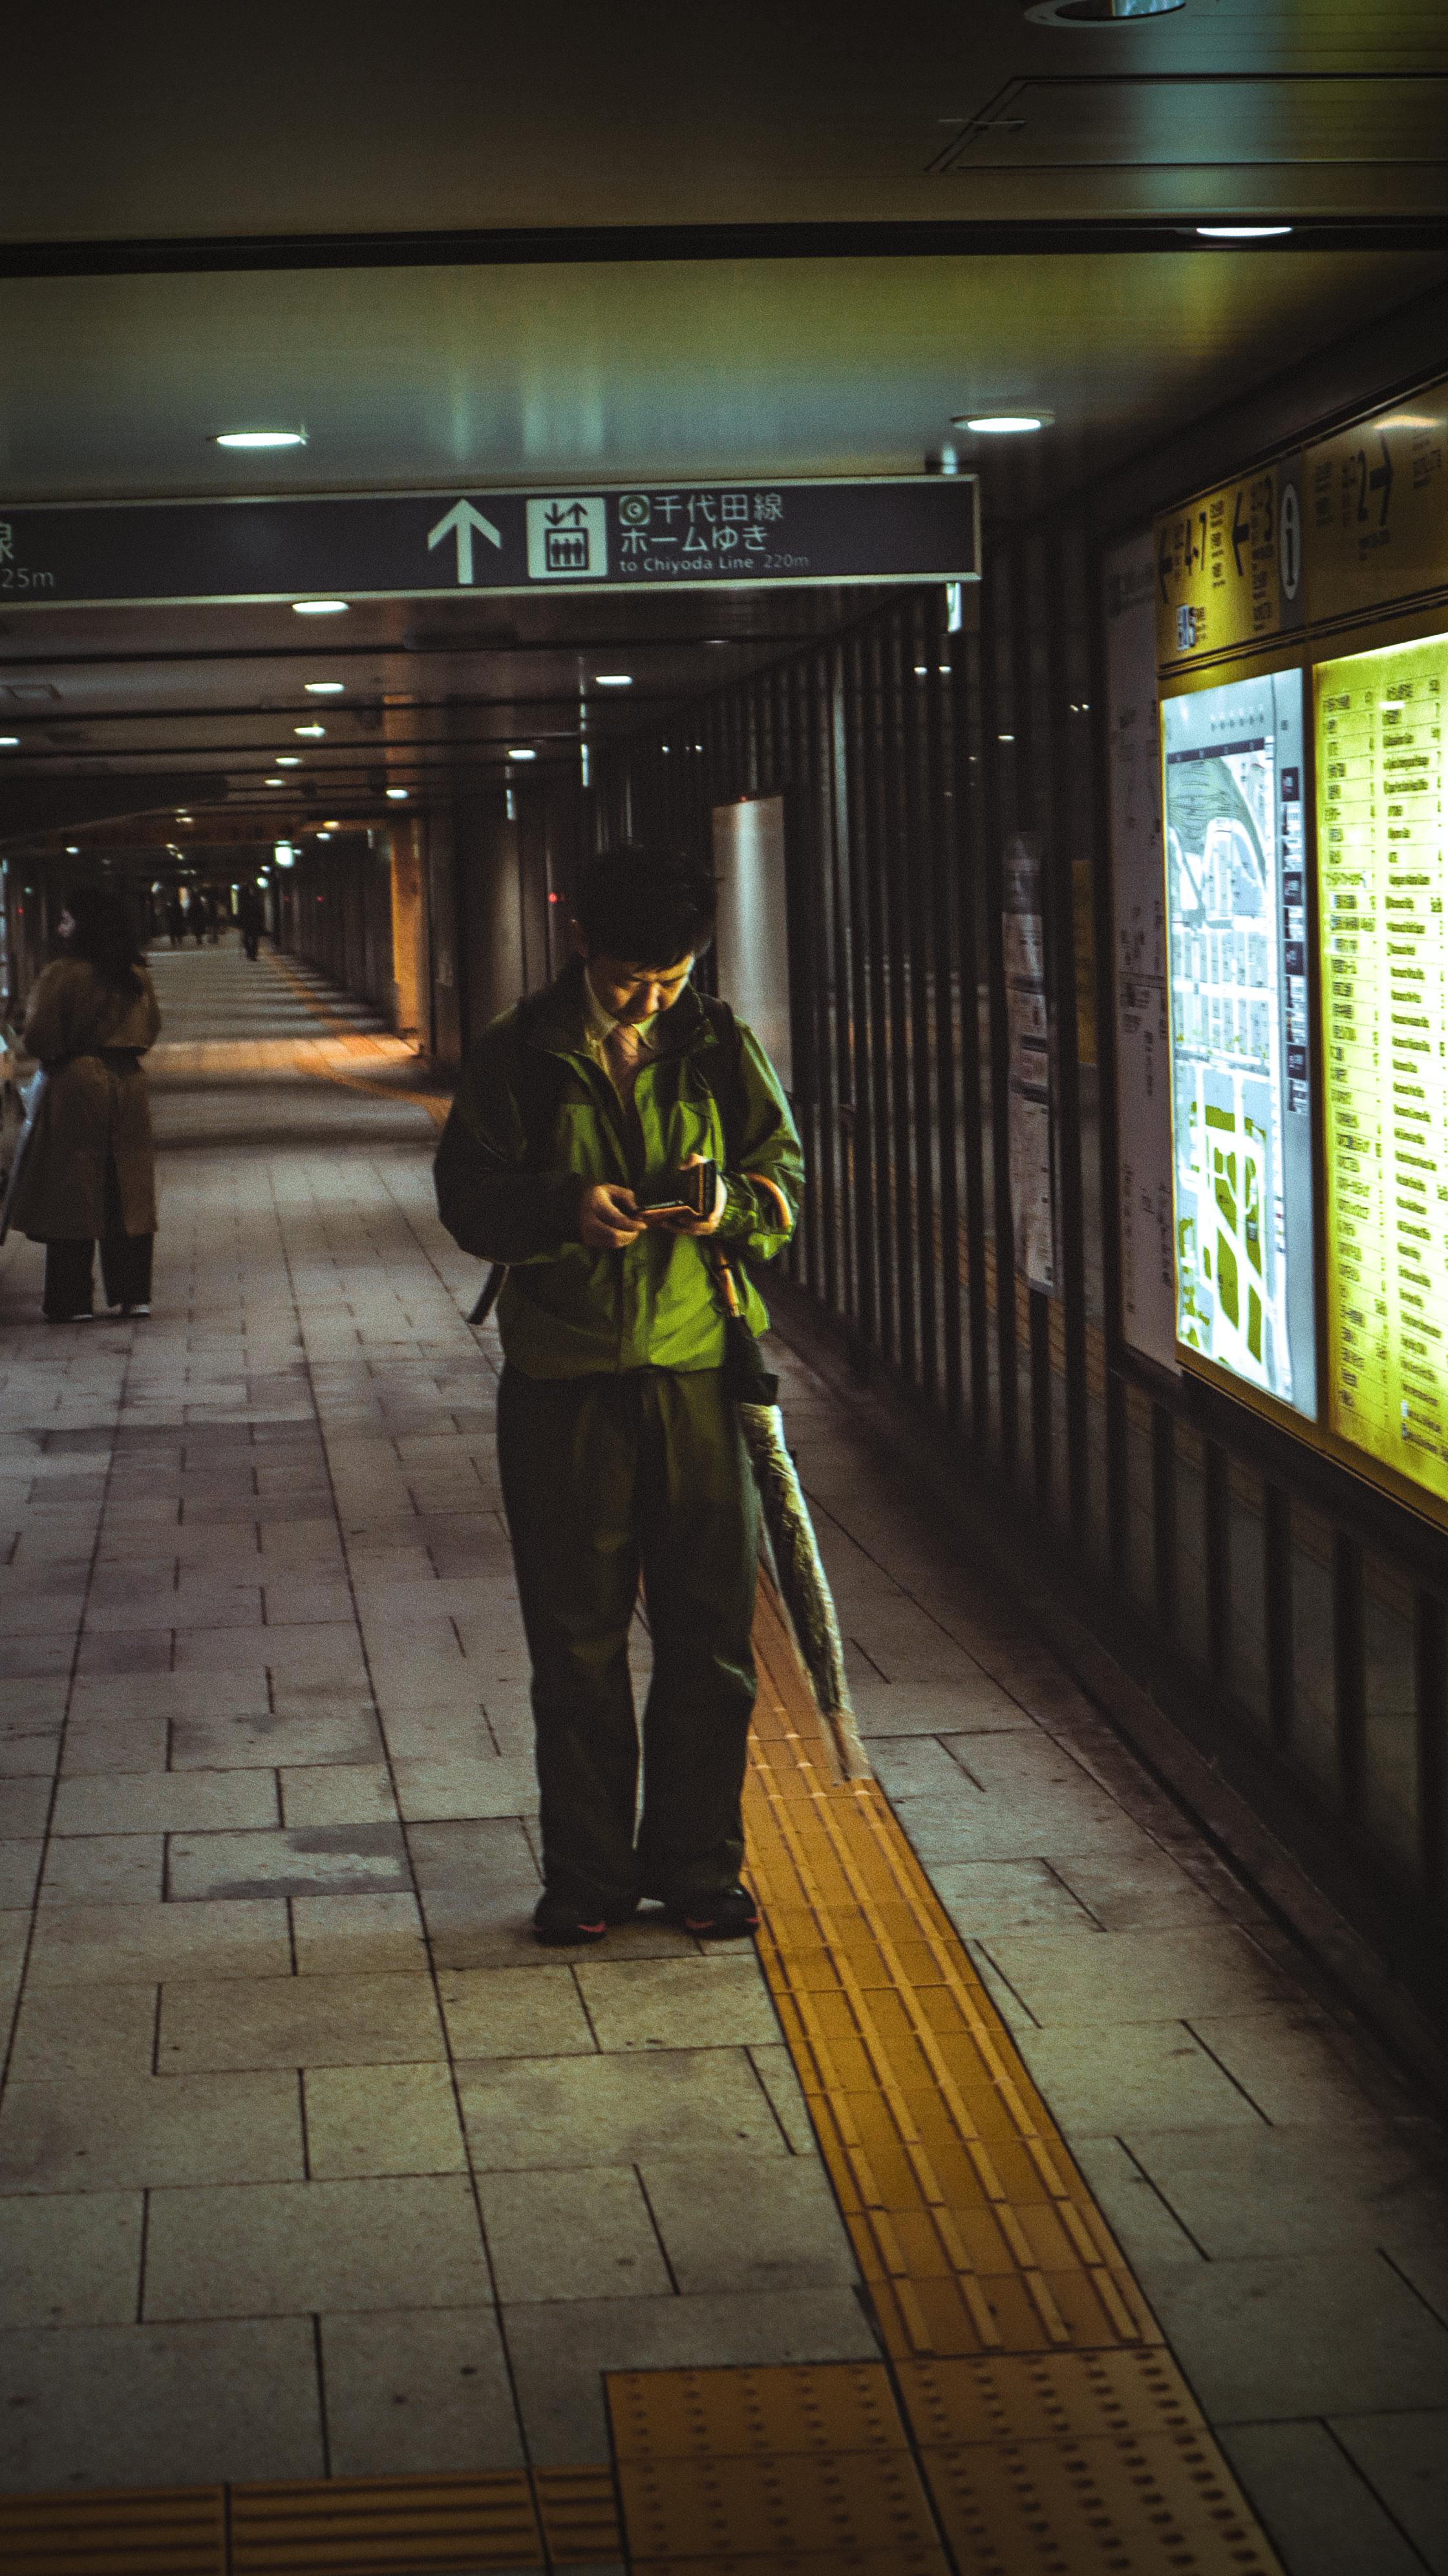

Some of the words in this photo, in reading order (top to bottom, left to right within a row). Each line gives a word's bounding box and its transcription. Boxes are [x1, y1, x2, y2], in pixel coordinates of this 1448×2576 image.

[654, 492, 783, 524] 千代田線
[621, 525, 769, 553] ホームゆき
[619, 560, 638, 572] to
[643, 556, 713, 575] Chiyoda
[719, 556, 754, 570] Line
[764, 553, 810, 568] 220m
